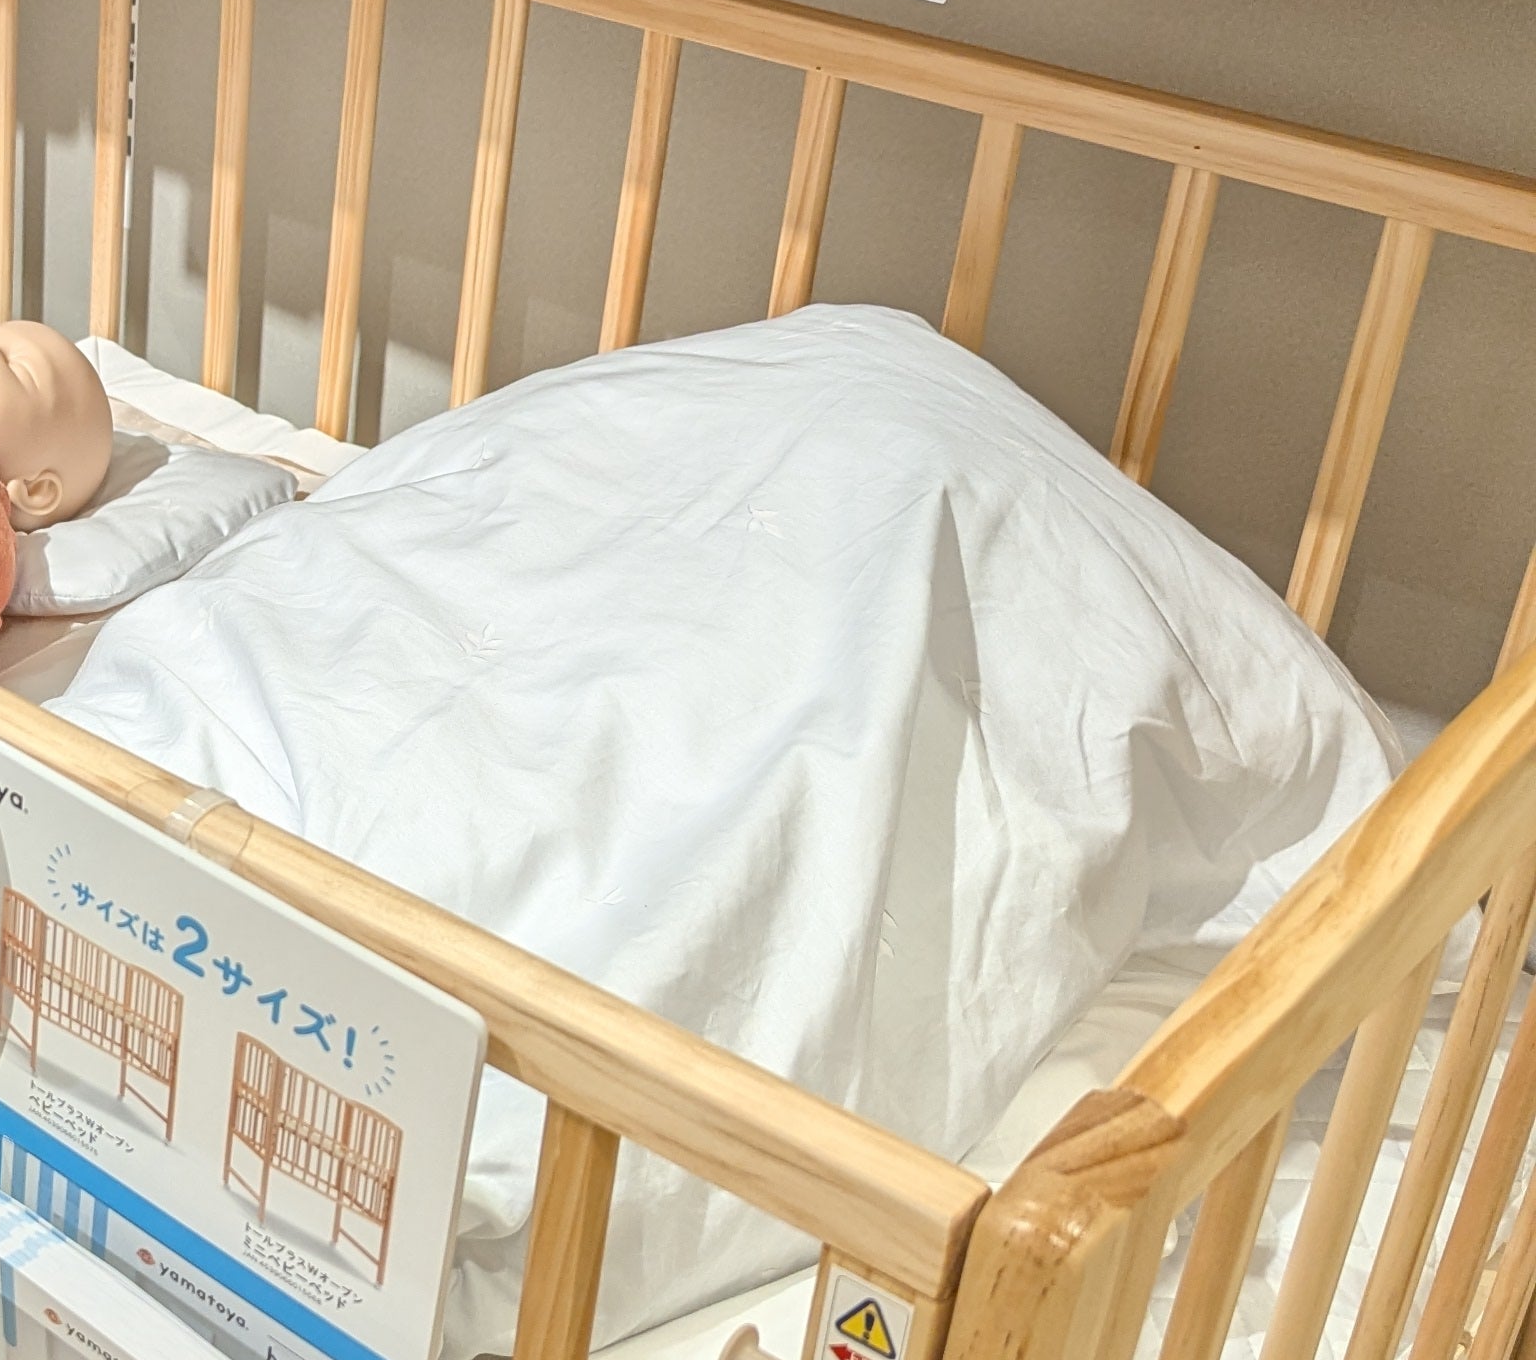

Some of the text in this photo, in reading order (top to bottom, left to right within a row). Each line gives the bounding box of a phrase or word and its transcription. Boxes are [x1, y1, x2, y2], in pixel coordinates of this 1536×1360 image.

[71, 881, 357, 1070] サイズは2サイズ!
